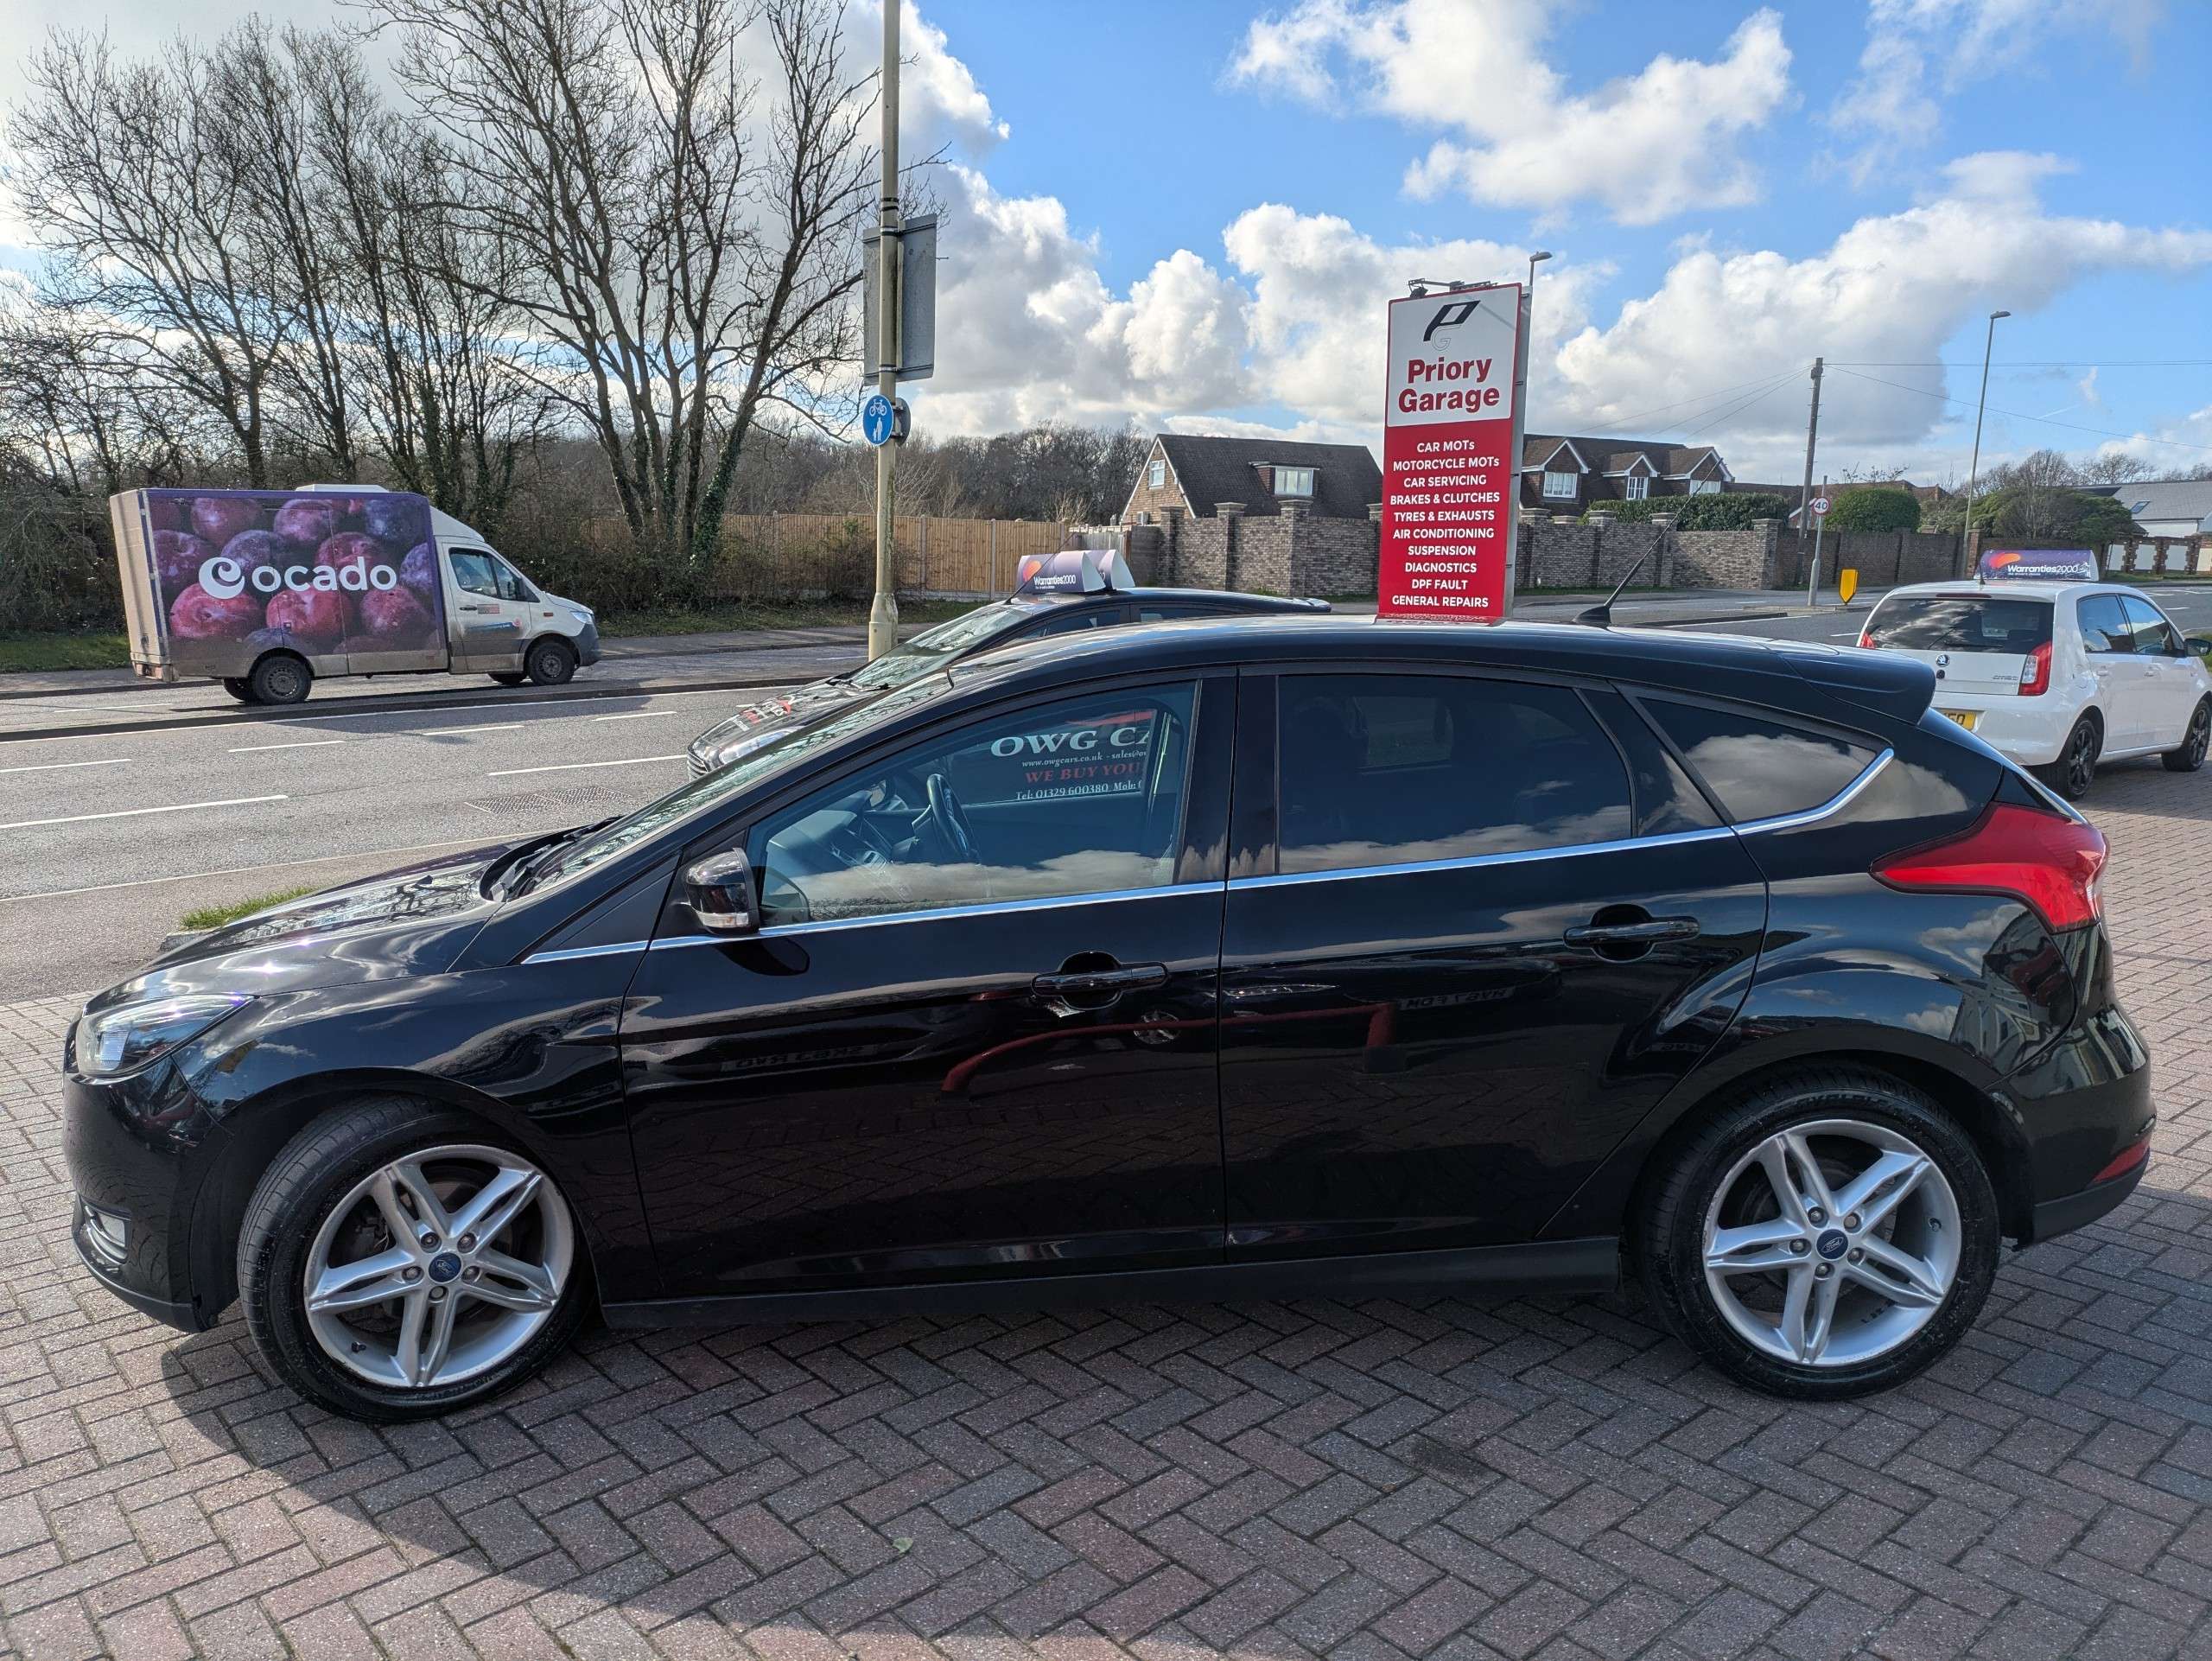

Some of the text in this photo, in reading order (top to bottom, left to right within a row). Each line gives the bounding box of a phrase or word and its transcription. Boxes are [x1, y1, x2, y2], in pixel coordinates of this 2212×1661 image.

[1408, 356, 1492, 384] Priory
[1398, 388, 1500, 413] Garage
[1417, 440, 1475, 453] CAR MOTs
[1393, 456, 1500, 471] MOTORCYCLE MOTs
[1404, 474, 1487, 487] CAR SERVICING
[1390, 492, 1500, 505] BRAKES & CLUTCHES
[1815, 501, 1828, 510] 40
[1394, 510, 1495, 522] TYRES & EXHAUSTS
[1393, 528, 1494, 539] AIR CONDITIONING
[1408, 545, 1476, 556] SUSPENSION
[251, 556, 397, 593] ocado
[1405, 563, 1478, 573] DIAGNOSTICS
[2007, 564, 2079, 573] Warranties2000
[1412, 579, 1468, 589] DPF FAULT
[1392, 595, 1489, 608] GENERAL REPAIRS
[991, 730, 1099, 757] OWG
[1025, 770, 1055, 784] WE
[1060, 766, 1098, 780] BUY
[1016, 790, 1033, 800] Tel:
[1035, 787, 1066, 799] 01329
[1068, 784, 1109, 796] 600380
